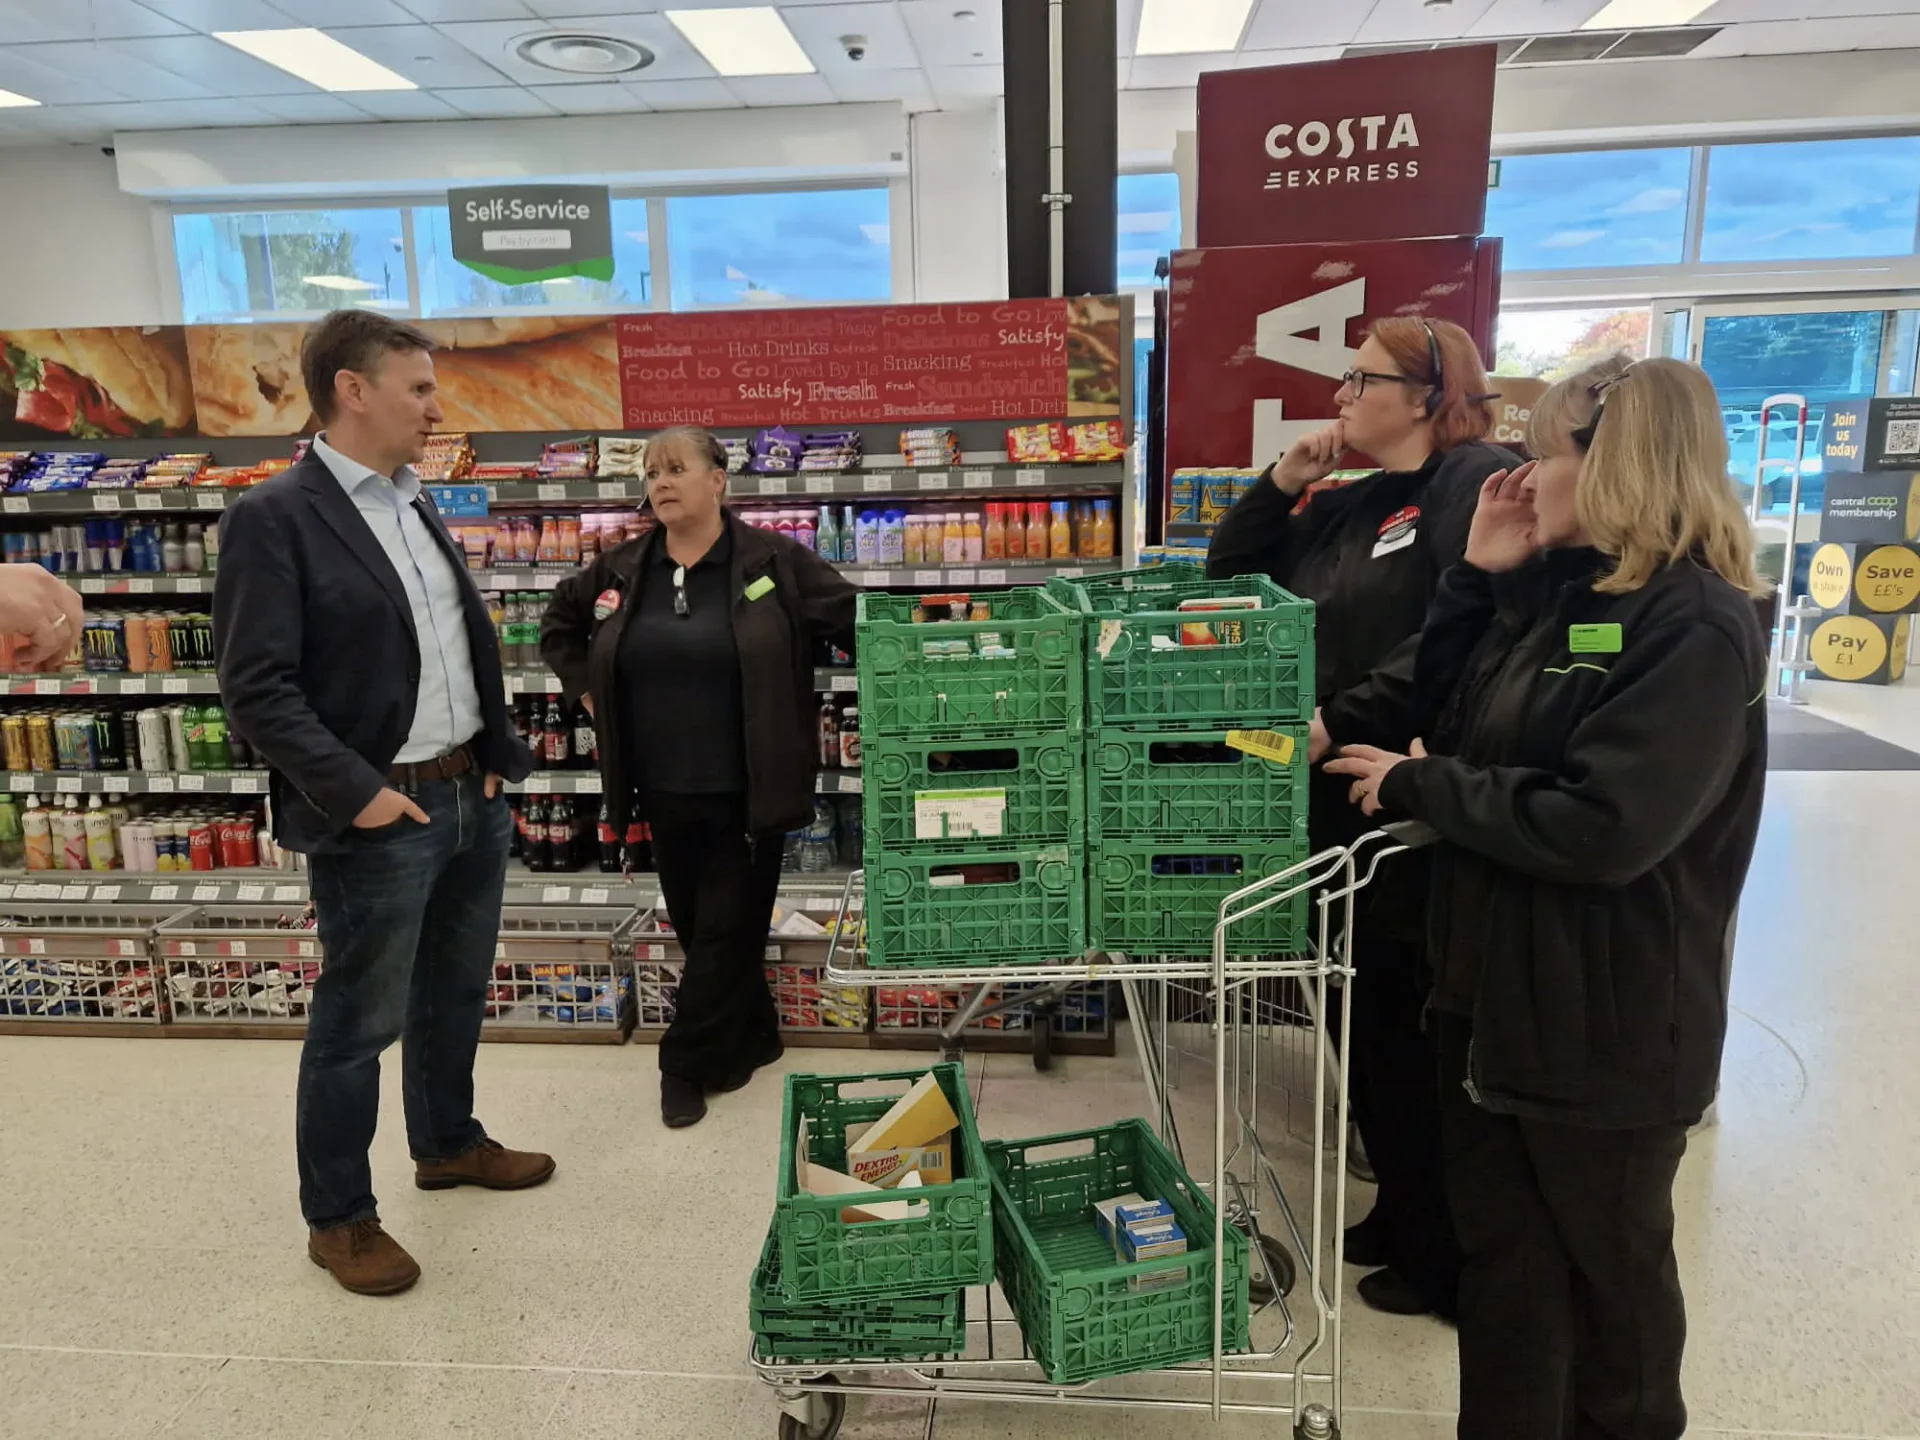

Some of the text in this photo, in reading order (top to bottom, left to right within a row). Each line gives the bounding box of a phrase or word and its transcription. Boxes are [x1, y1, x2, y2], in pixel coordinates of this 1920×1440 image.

[1264, 112, 1419, 160] COSTA
[1287, 160, 1420, 188] EXPRESS
[465, 198, 591, 222] Self-Service
[882, 304, 946, 326] Food
[957, 306, 981, 324] to
[992, 304, 1031, 323] Go
[998, 323, 1065, 352] Satisfy
[622, 342, 693, 358] Breakfast
[728, 341, 761, 358] Hot
[765, 339, 829, 357] Drinks
[626, 360, 879, 381] Food to Go Loved By Us
[883, 352, 972, 372] Snacking
[738, 378, 802, 407] Satisfy
[806, 378, 878, 402] Fresh
[628, 406, 714, 425] Snacking
[780, 406, 810, 422] Hot
[818, 405, 881, 420] Drinks
[882, 401, 955, 416] Breakfast
[991, 399, 1024, 415] Hot
[1832, 412, 1856, 426] Join
[1836, 430, 1850, 441] us
[1826, 443, 1858, 459] today
[1831, 497, 1865, 506] central
[1829, 508, 1897, 520] membership
[1816, 561, 1843, 577] Own
[1866, 565, 1914, 579] Save
[1828, 633, 1868, 652] Pay
[1835, 653, 1854, 665] £1
[853, 1154, 899, 1173] DEXTRO
[860, 1162, 898, 1182] ENERGY
